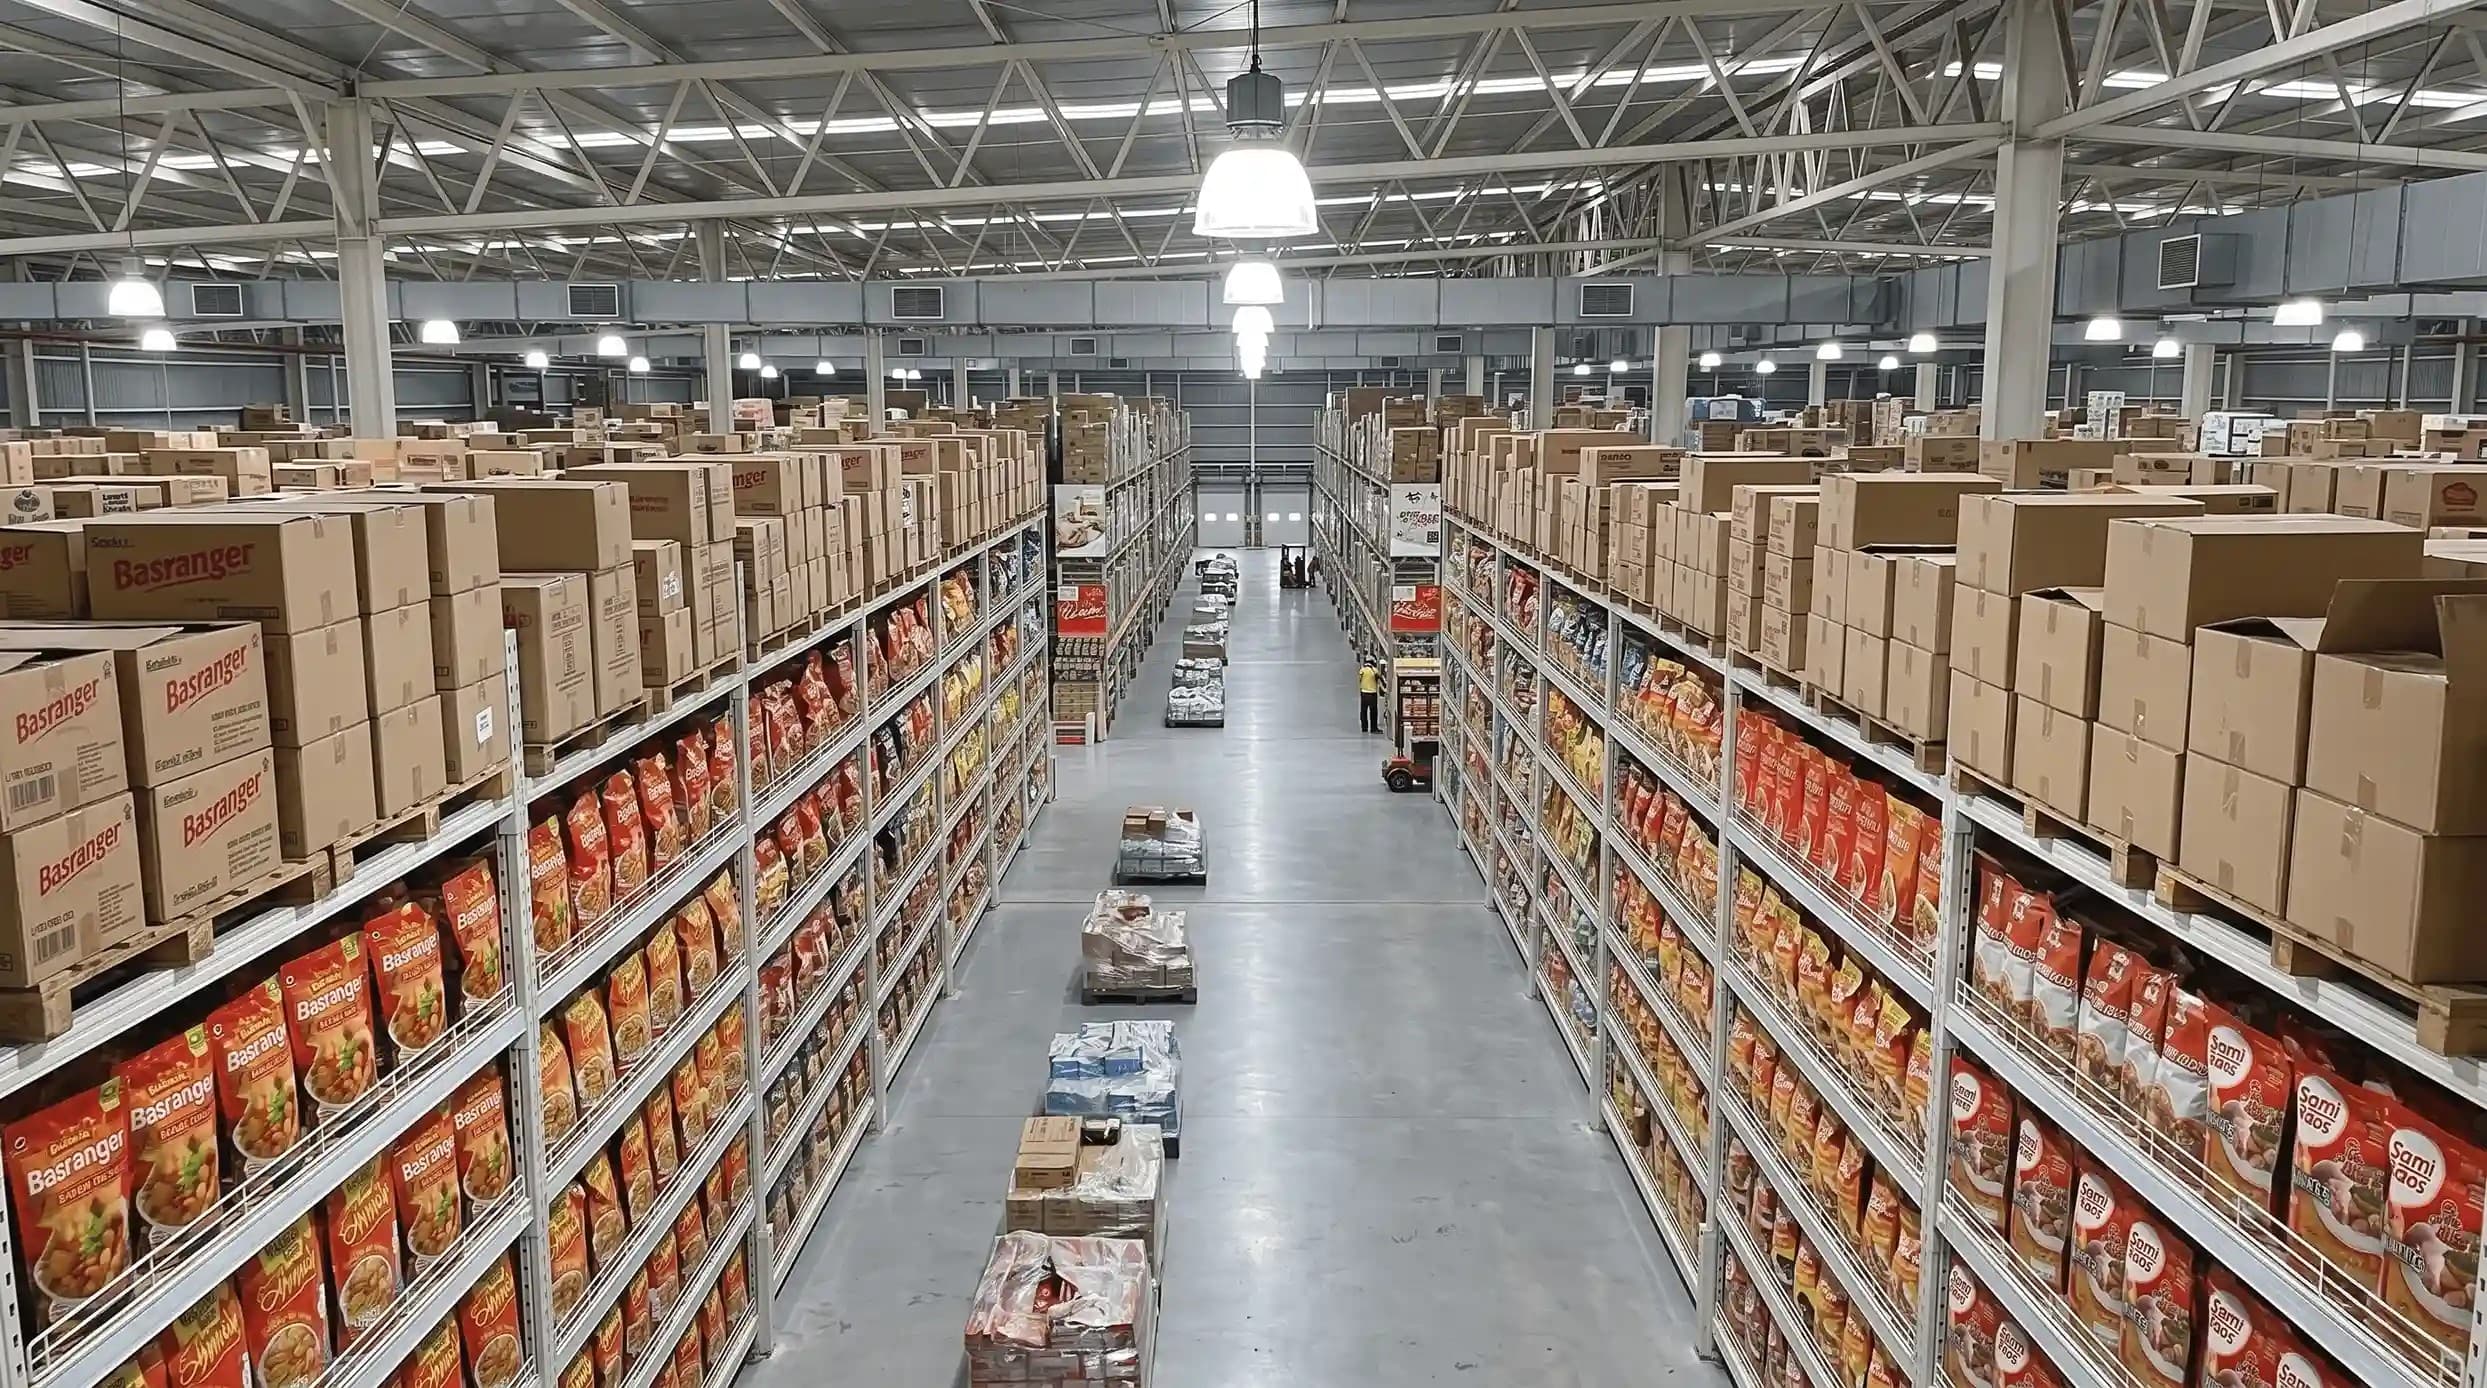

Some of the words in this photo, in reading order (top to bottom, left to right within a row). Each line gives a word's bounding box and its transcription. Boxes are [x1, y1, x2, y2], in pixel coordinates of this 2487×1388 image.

[113, 543, 255, 591] Basranger
[166, 644, 248, 714] Basranger
[15, 678, 99, 744] Basranger
[183, 771, 262, 848] Basranger
[39, 822, 122, 897] Basranger
[296, 974, 364, 1021] Basranger
[2209, 1034, 2246, 1062] Sami
[2299, 1086, 2341, 1120] Sami
[26, 1127, 125, 1196] Basranger
[2391, 1140, 2436, 1178] Sami
[2080, 1181, 2109, 1209] Sami
[2130, 1231, 2161, 1262] Sami
[2209, 1299, 2245, 1332] Sami
